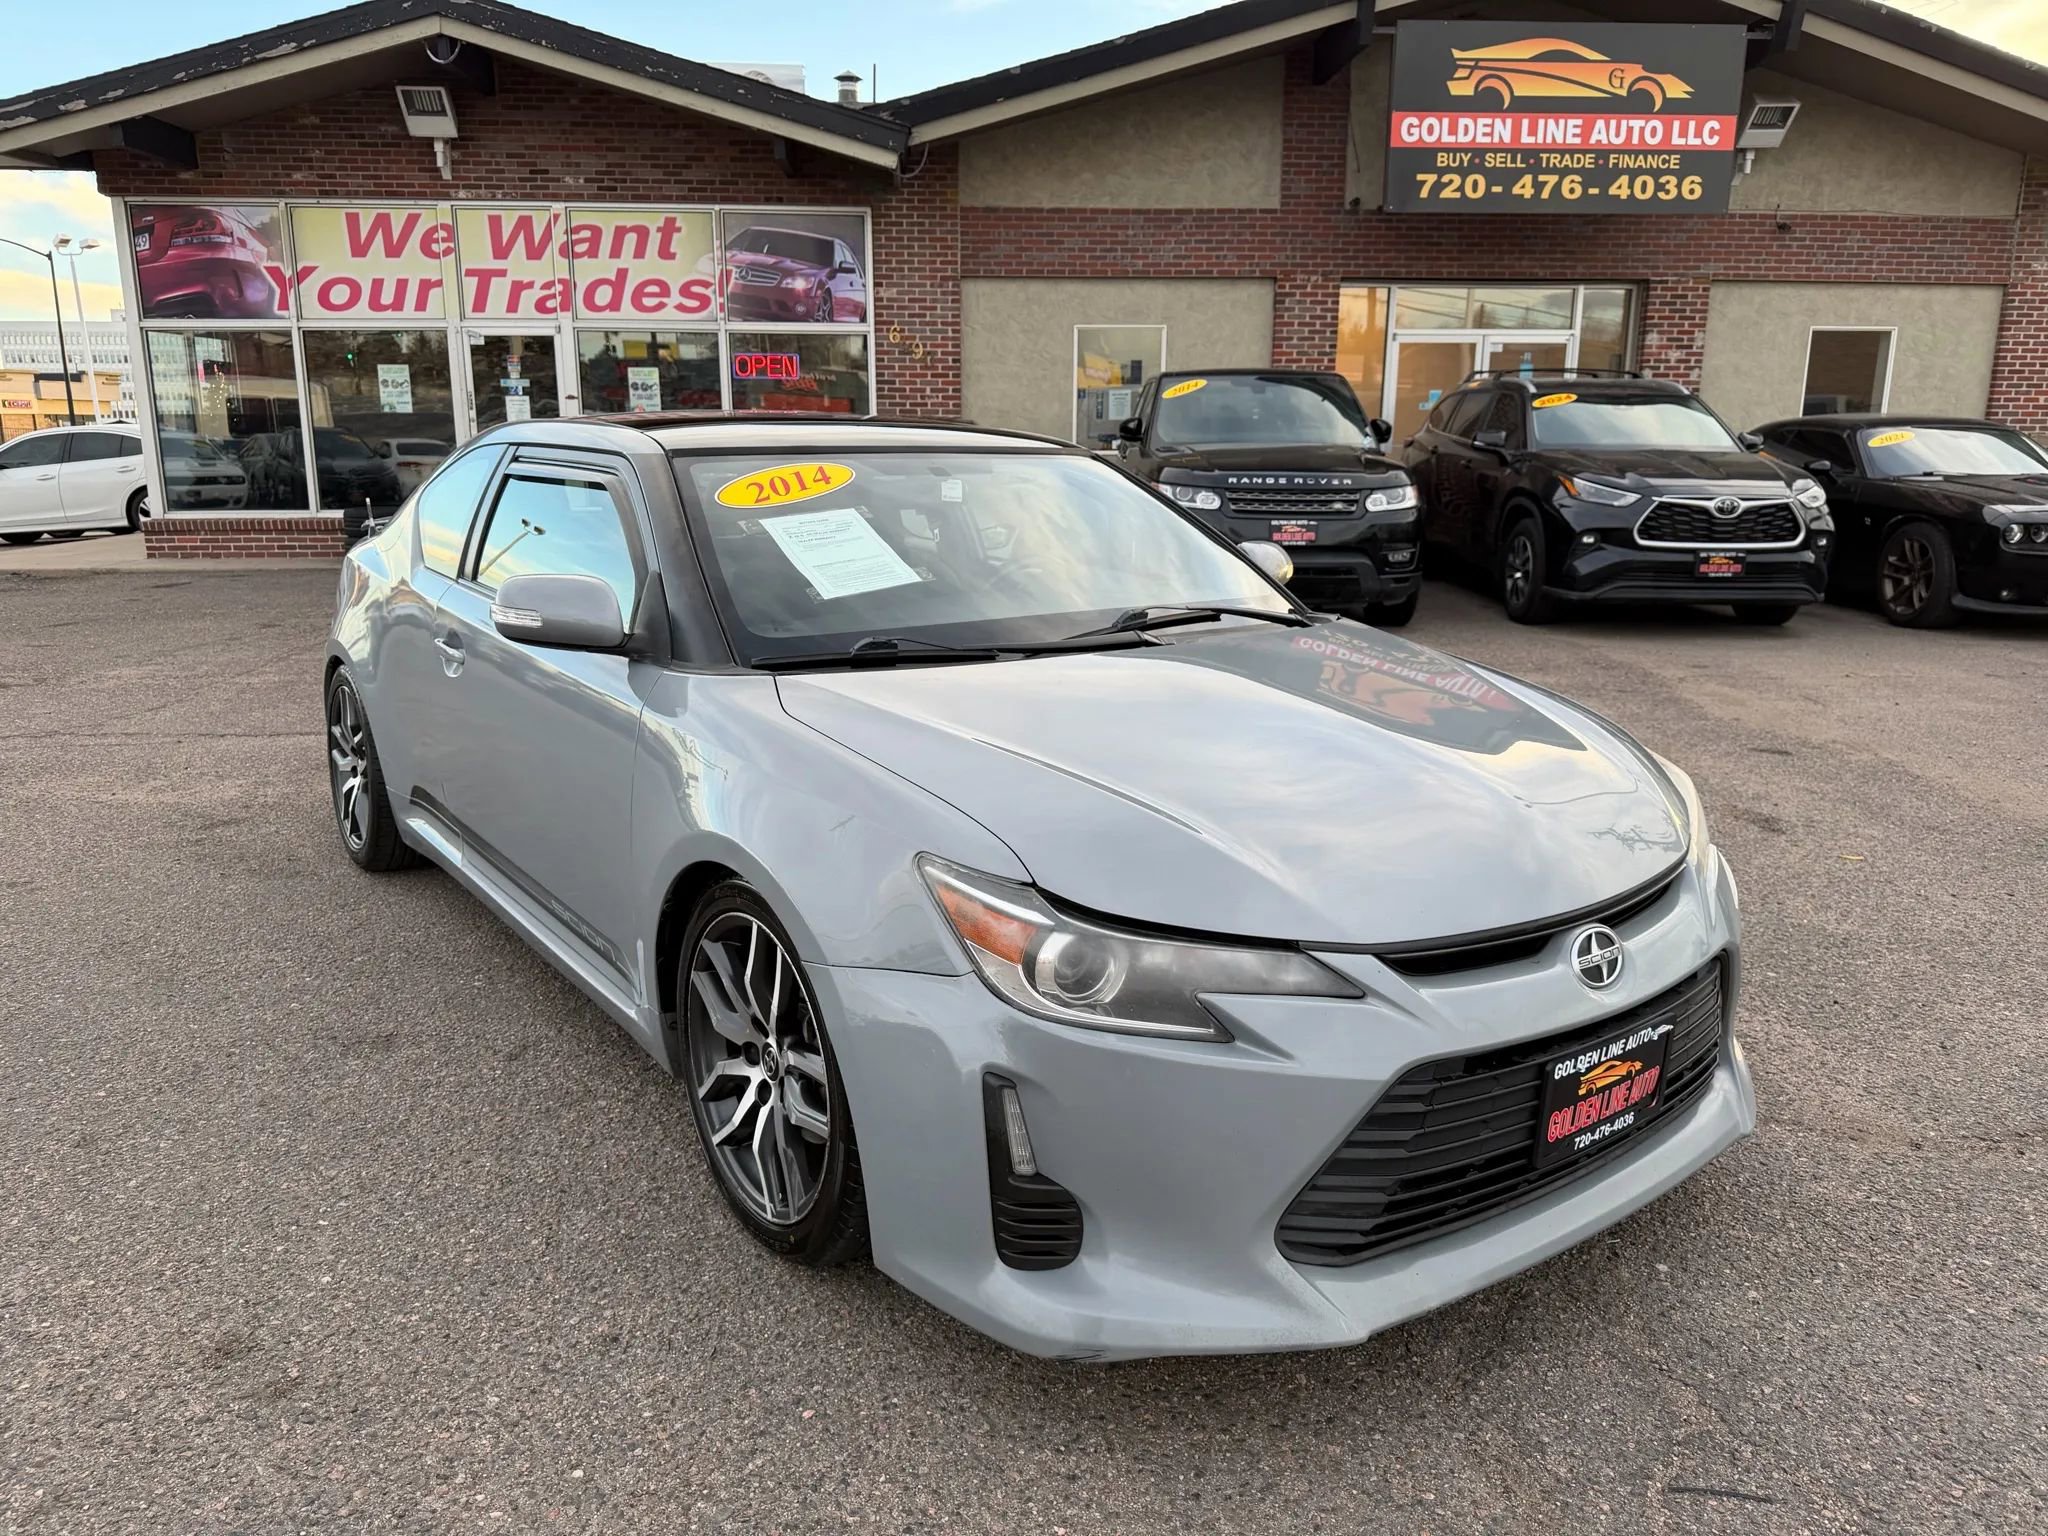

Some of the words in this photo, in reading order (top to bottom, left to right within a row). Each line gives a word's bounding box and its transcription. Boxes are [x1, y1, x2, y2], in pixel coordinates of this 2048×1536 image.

[1400, 116, 1513, 144] GOLDEN
[1520, 118, 1583, 144] LINE
[1589, 118, 1663, 145] AUTO
[1671, 120, 1721, 146] LLC
[1436, 152, 1472, 168] BUY
[1484, 152, 1526, 168] SELL
[1539, 153, 1596, 168] TRADE
[1608, 154, 1681, 169] FINANCE
[344, 210, 456, 260] We
[486, 212, 682, 261] Want
[264, 264, 444, 314] Your
[463, 265, 734, 315] Trades!
[734, 354, 797, 378] OPEN
[746, 465, 832, 504] 2014
[1228, 477, 1288, 485] RANGE
[1294, 477, 1353, 486] ROVER
[1554, 1048, 1601, 1080] GOLDEN
[1600, 1038, 1626, 1061] LINE
[1625, 1026, 1653, 1052] AUTO
[1547, 1092, 1603, 1142] GOLDEN
[1600, 1079, 1632, 1120] LINE
[1627, 1065, 1660, 1107] AUTO
[1574, 1111, 1635, 1151] 720-476-4036
